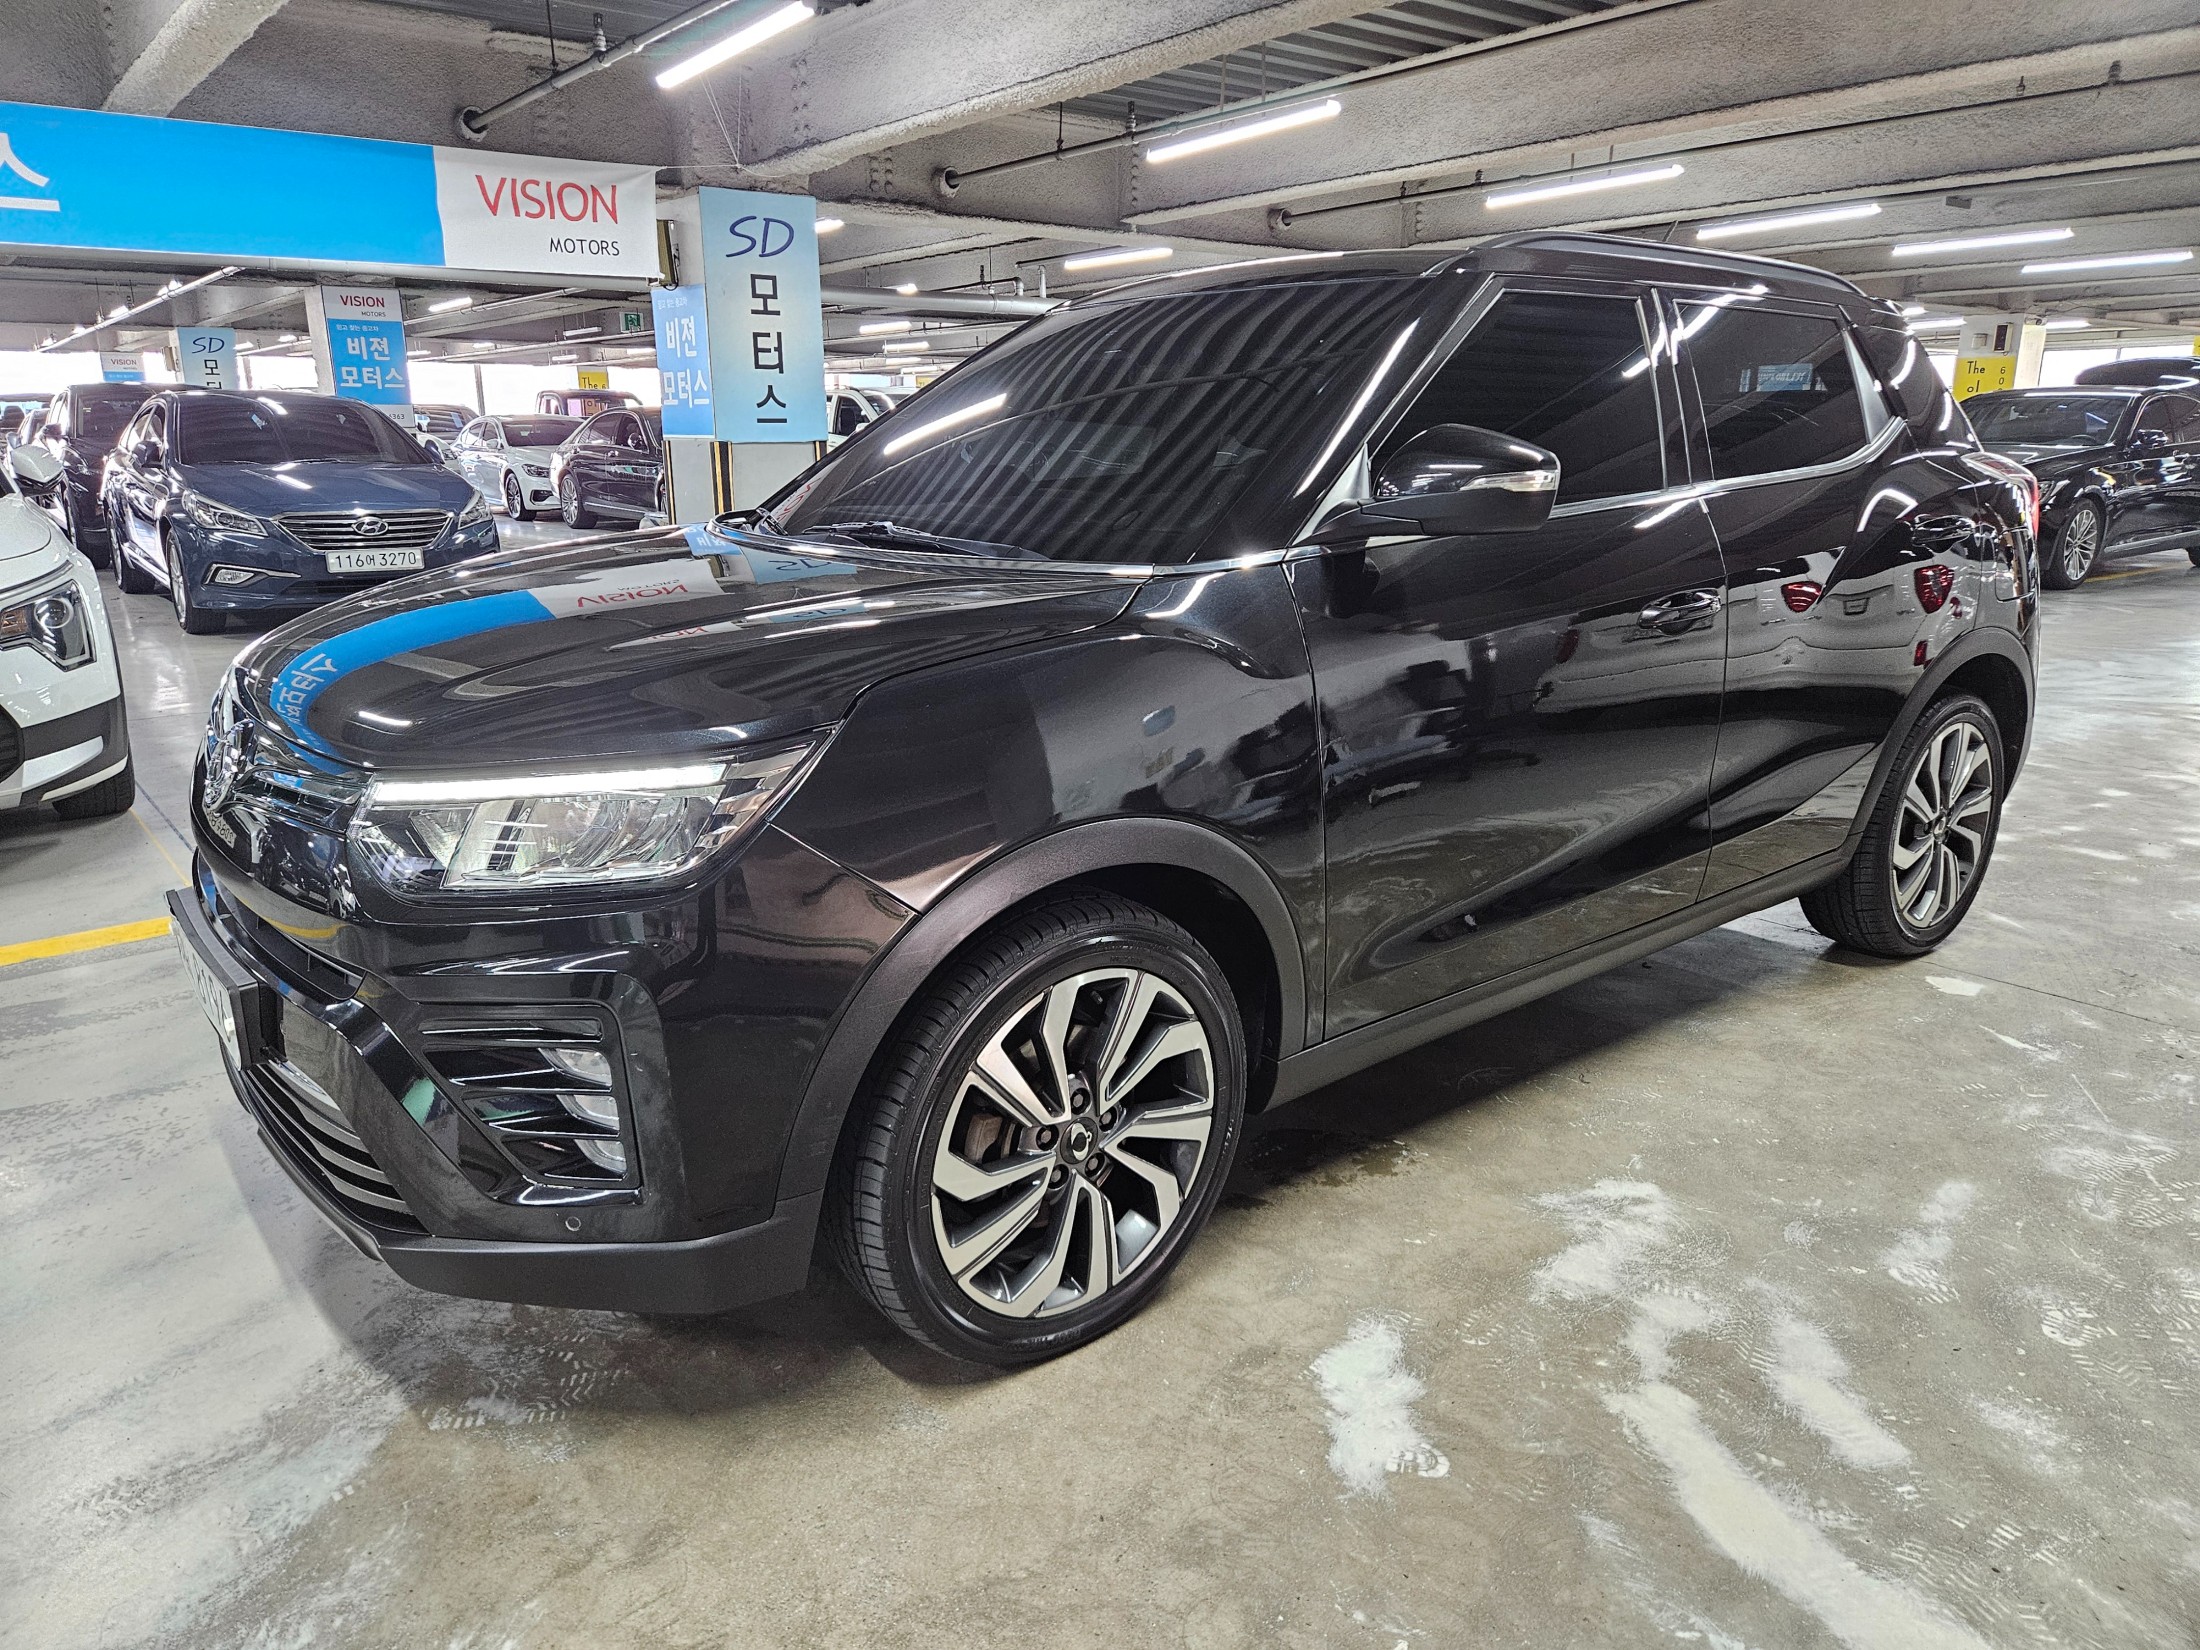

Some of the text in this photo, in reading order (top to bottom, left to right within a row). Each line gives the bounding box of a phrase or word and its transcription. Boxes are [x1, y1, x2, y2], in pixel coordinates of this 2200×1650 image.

[475, 174, 618, 225] VISION
[726, 215, 795, 258] SD
[550, 237, 620, 256] MOTORS
[340, 294, 385, 308] VISION
[192, 337, 225, 354] SD
[750, 273, 788, 424] 모터스
[111, 358, 137, 366] VISION
[1967, 360, 1986, 374] The
[340, 366, 406, 390] 모터스
[582, 377, 599, 390] The
[663, 368, 710, 409] 모터스
